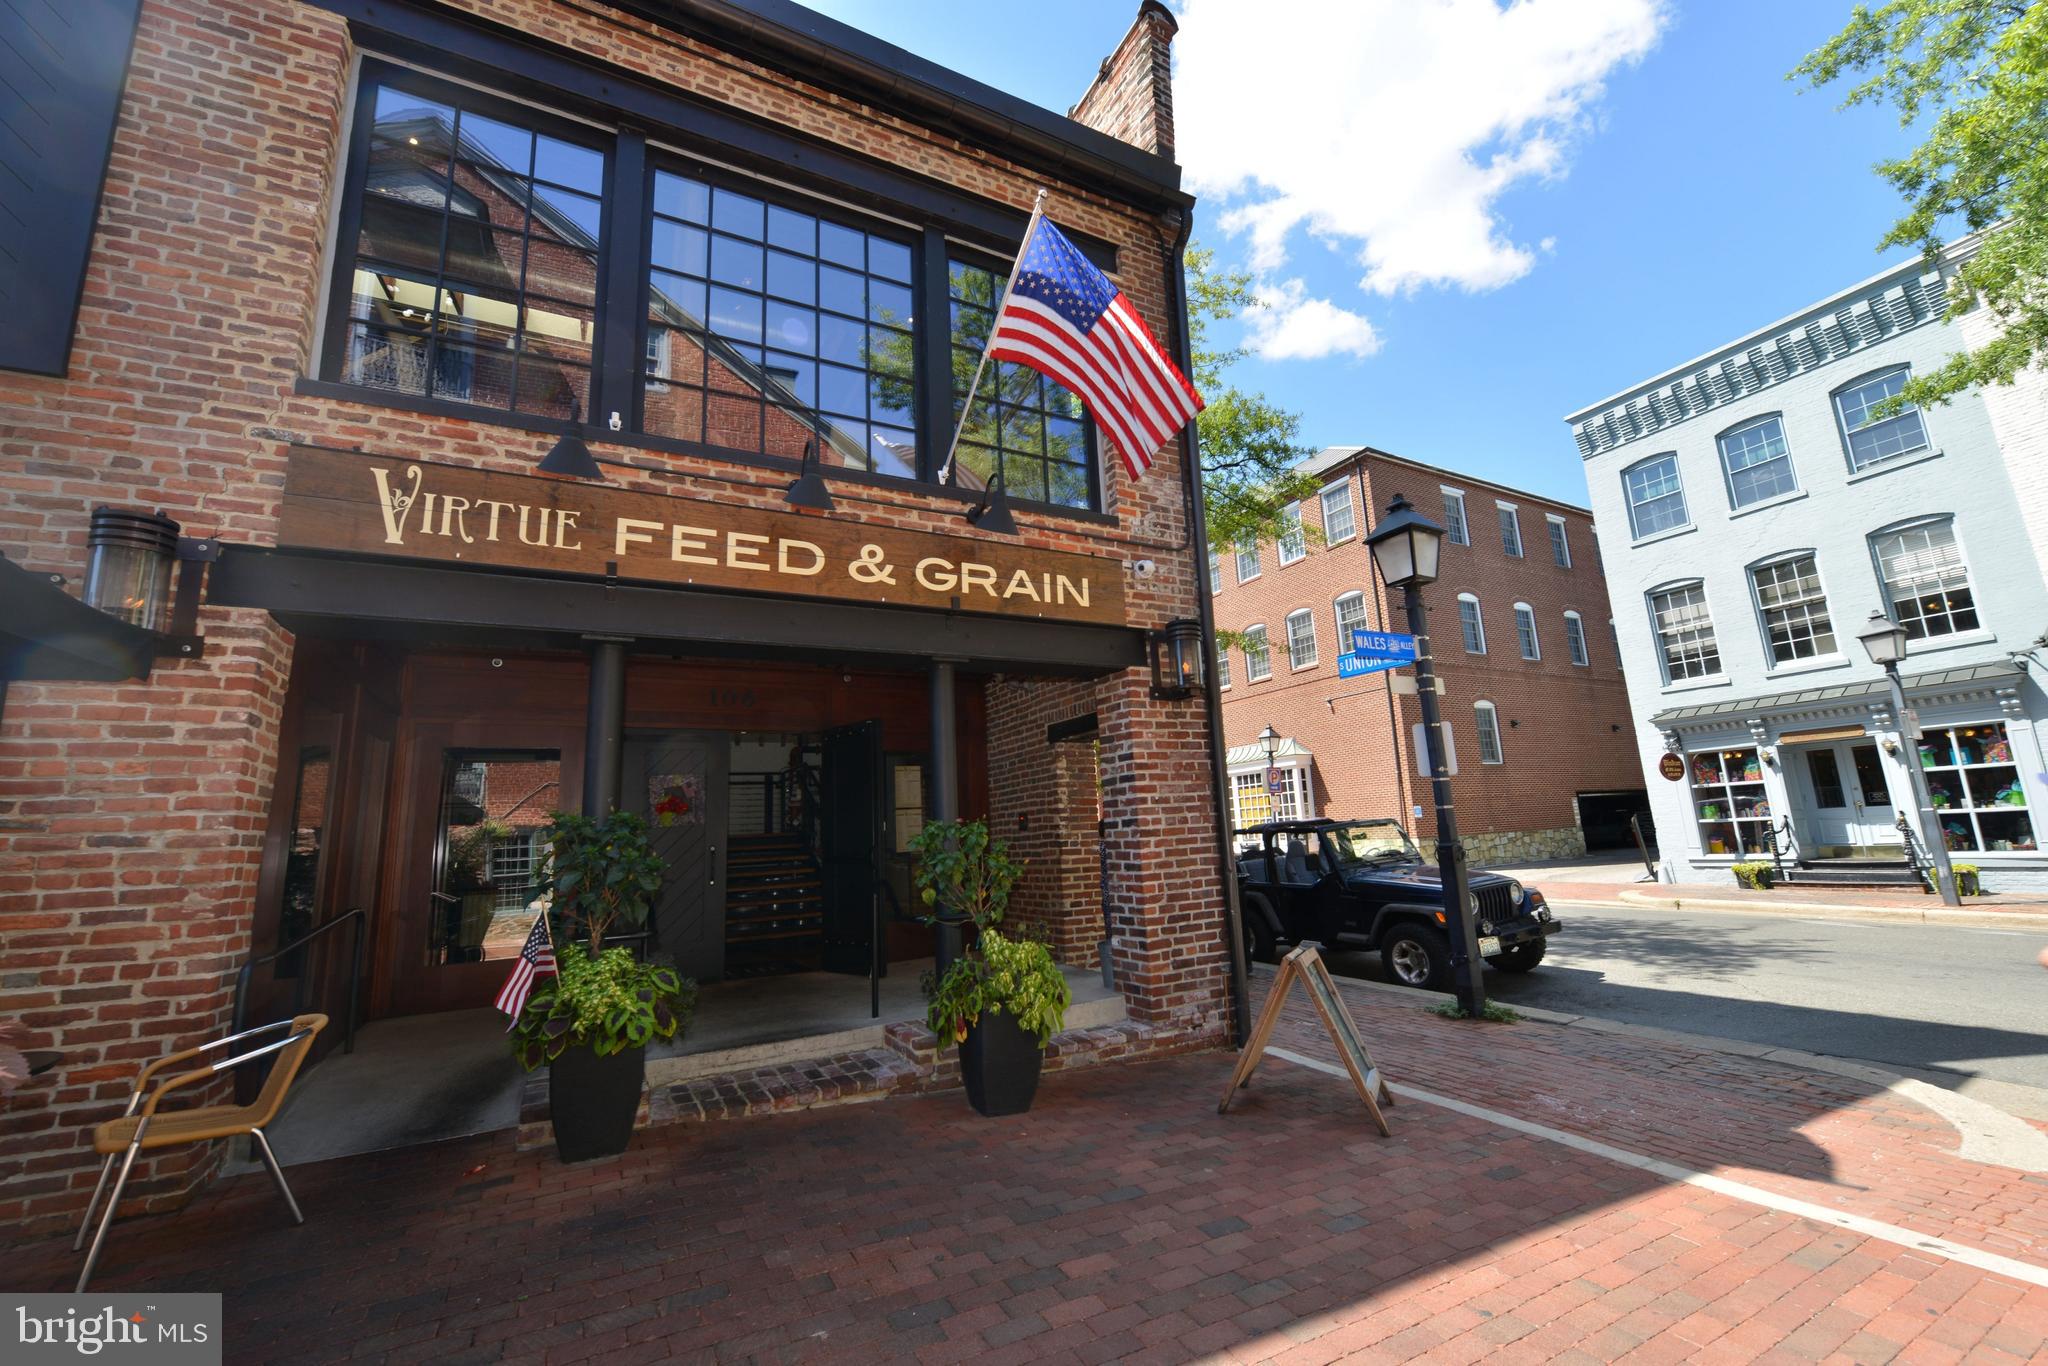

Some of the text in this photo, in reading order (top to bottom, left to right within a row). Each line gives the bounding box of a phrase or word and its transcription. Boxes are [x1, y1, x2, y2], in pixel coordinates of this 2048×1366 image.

[615, 517, 826, 576] FEED
[848, 543, 897, 586] &
[915, 557, 1091, 607] GRAIN
[1355, 635, 1387, 651] WALES
[1339, 657, 1382, 672] S UNION
